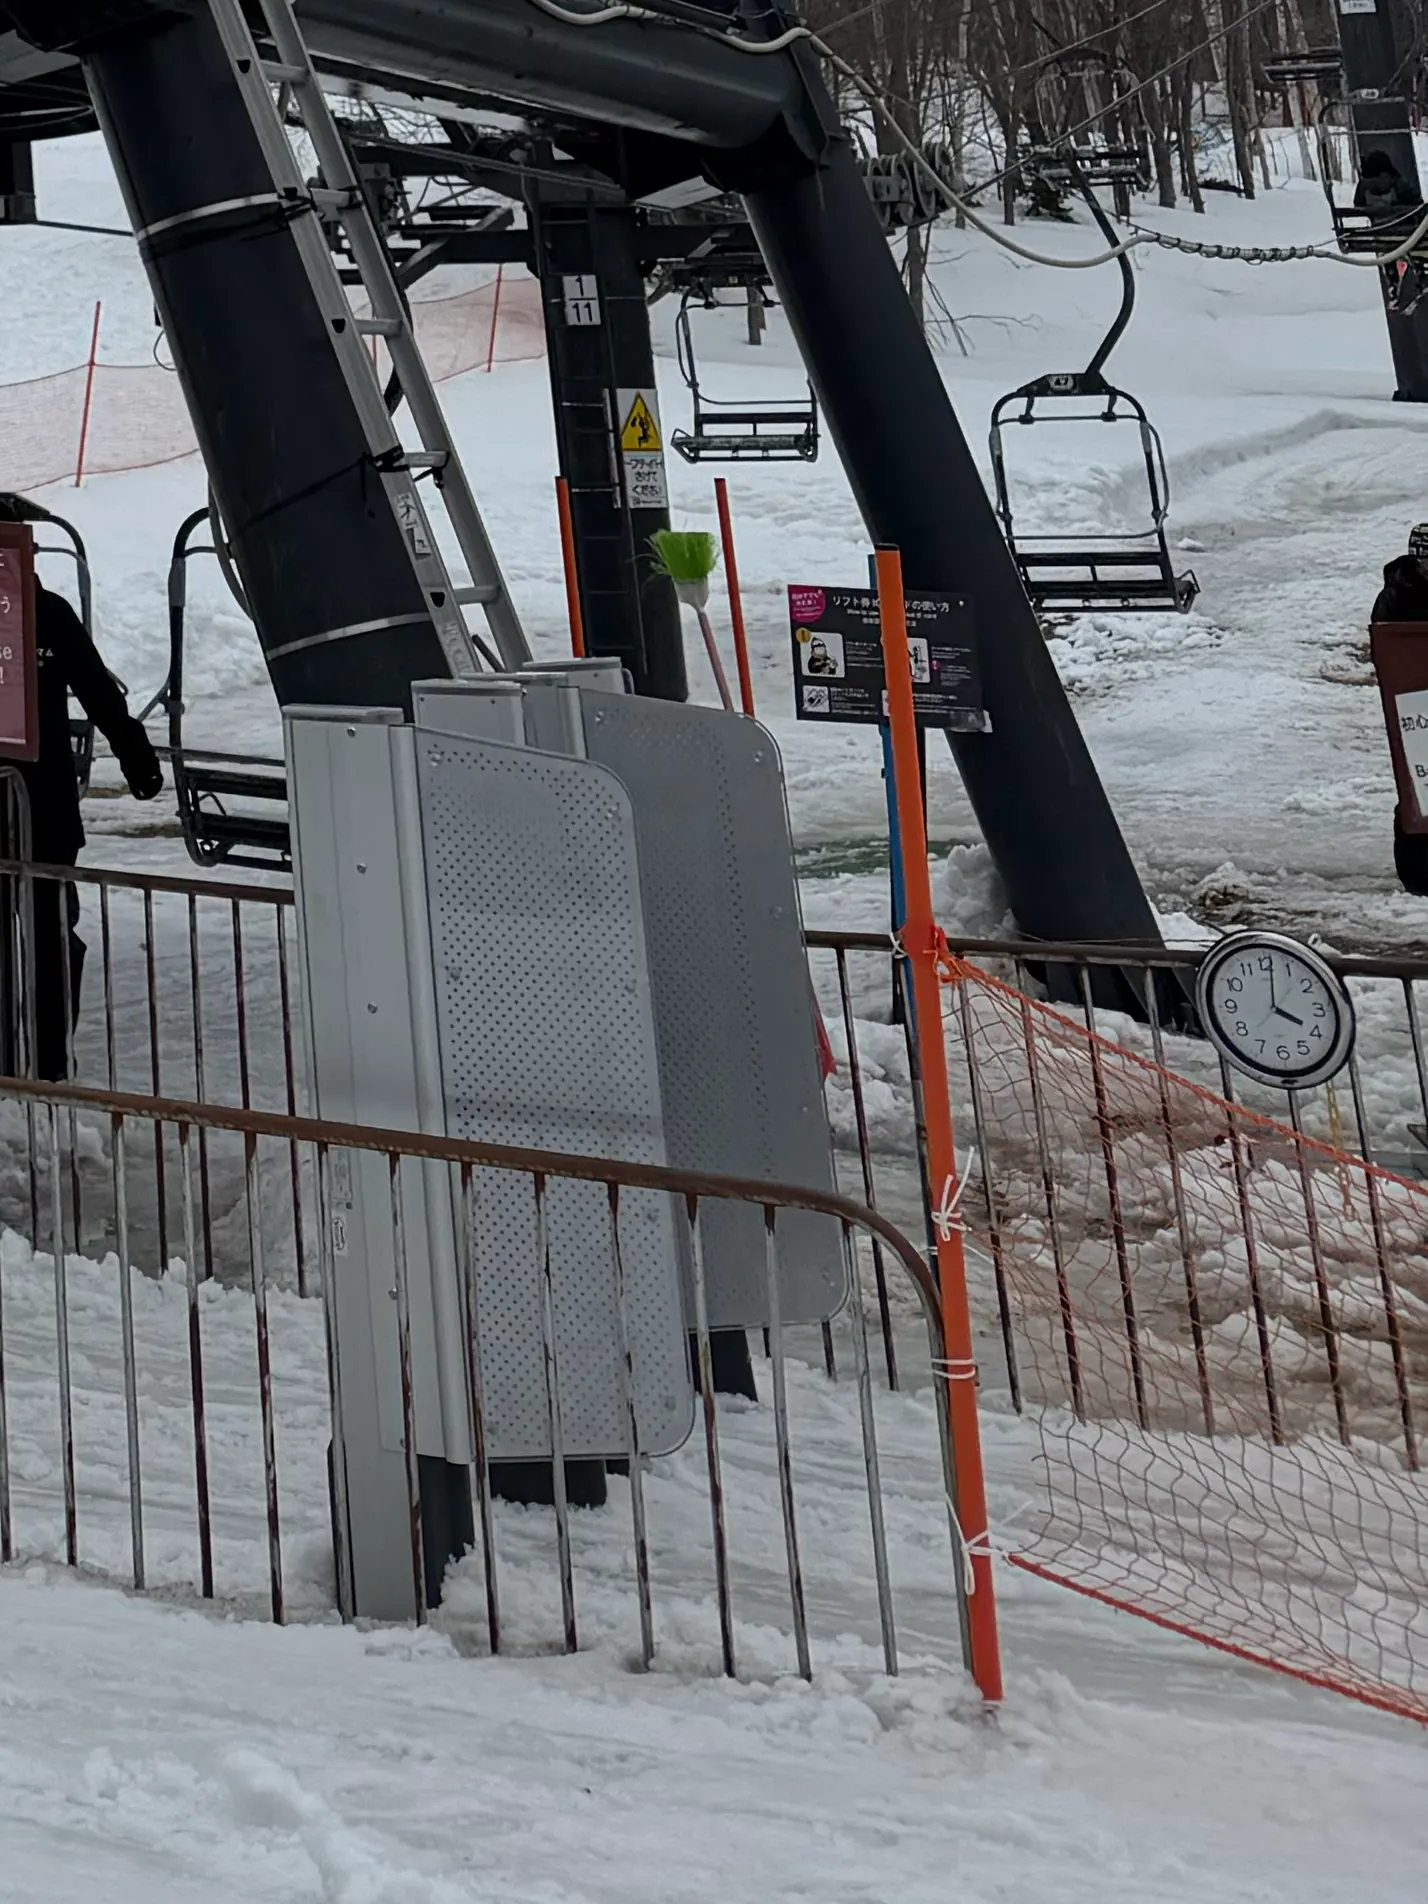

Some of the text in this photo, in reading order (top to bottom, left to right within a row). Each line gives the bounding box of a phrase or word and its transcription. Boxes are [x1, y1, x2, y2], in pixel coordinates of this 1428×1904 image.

[575, 276, 584, 296] 1
[572, 302, 593, 323] 11
[1240, 963, 1253, 976] 11
[1286, 963, 1292, 977] 1
[1227, 977, 1244, 992] 10
[1300, 978, 1313, 994] 2
[1224, 999, 1239, 1014] 9
[1312, 1002, 1326, 1018] 3
[1236, 1021, 1249, 1037] 8
[1309, 1024, 1323, 1040] 4
[1254, 1039, 1266, 1053] 7
[1276, 1046, 1291, 1060] 6
[1297, 1040, 1311, 1056] 5
